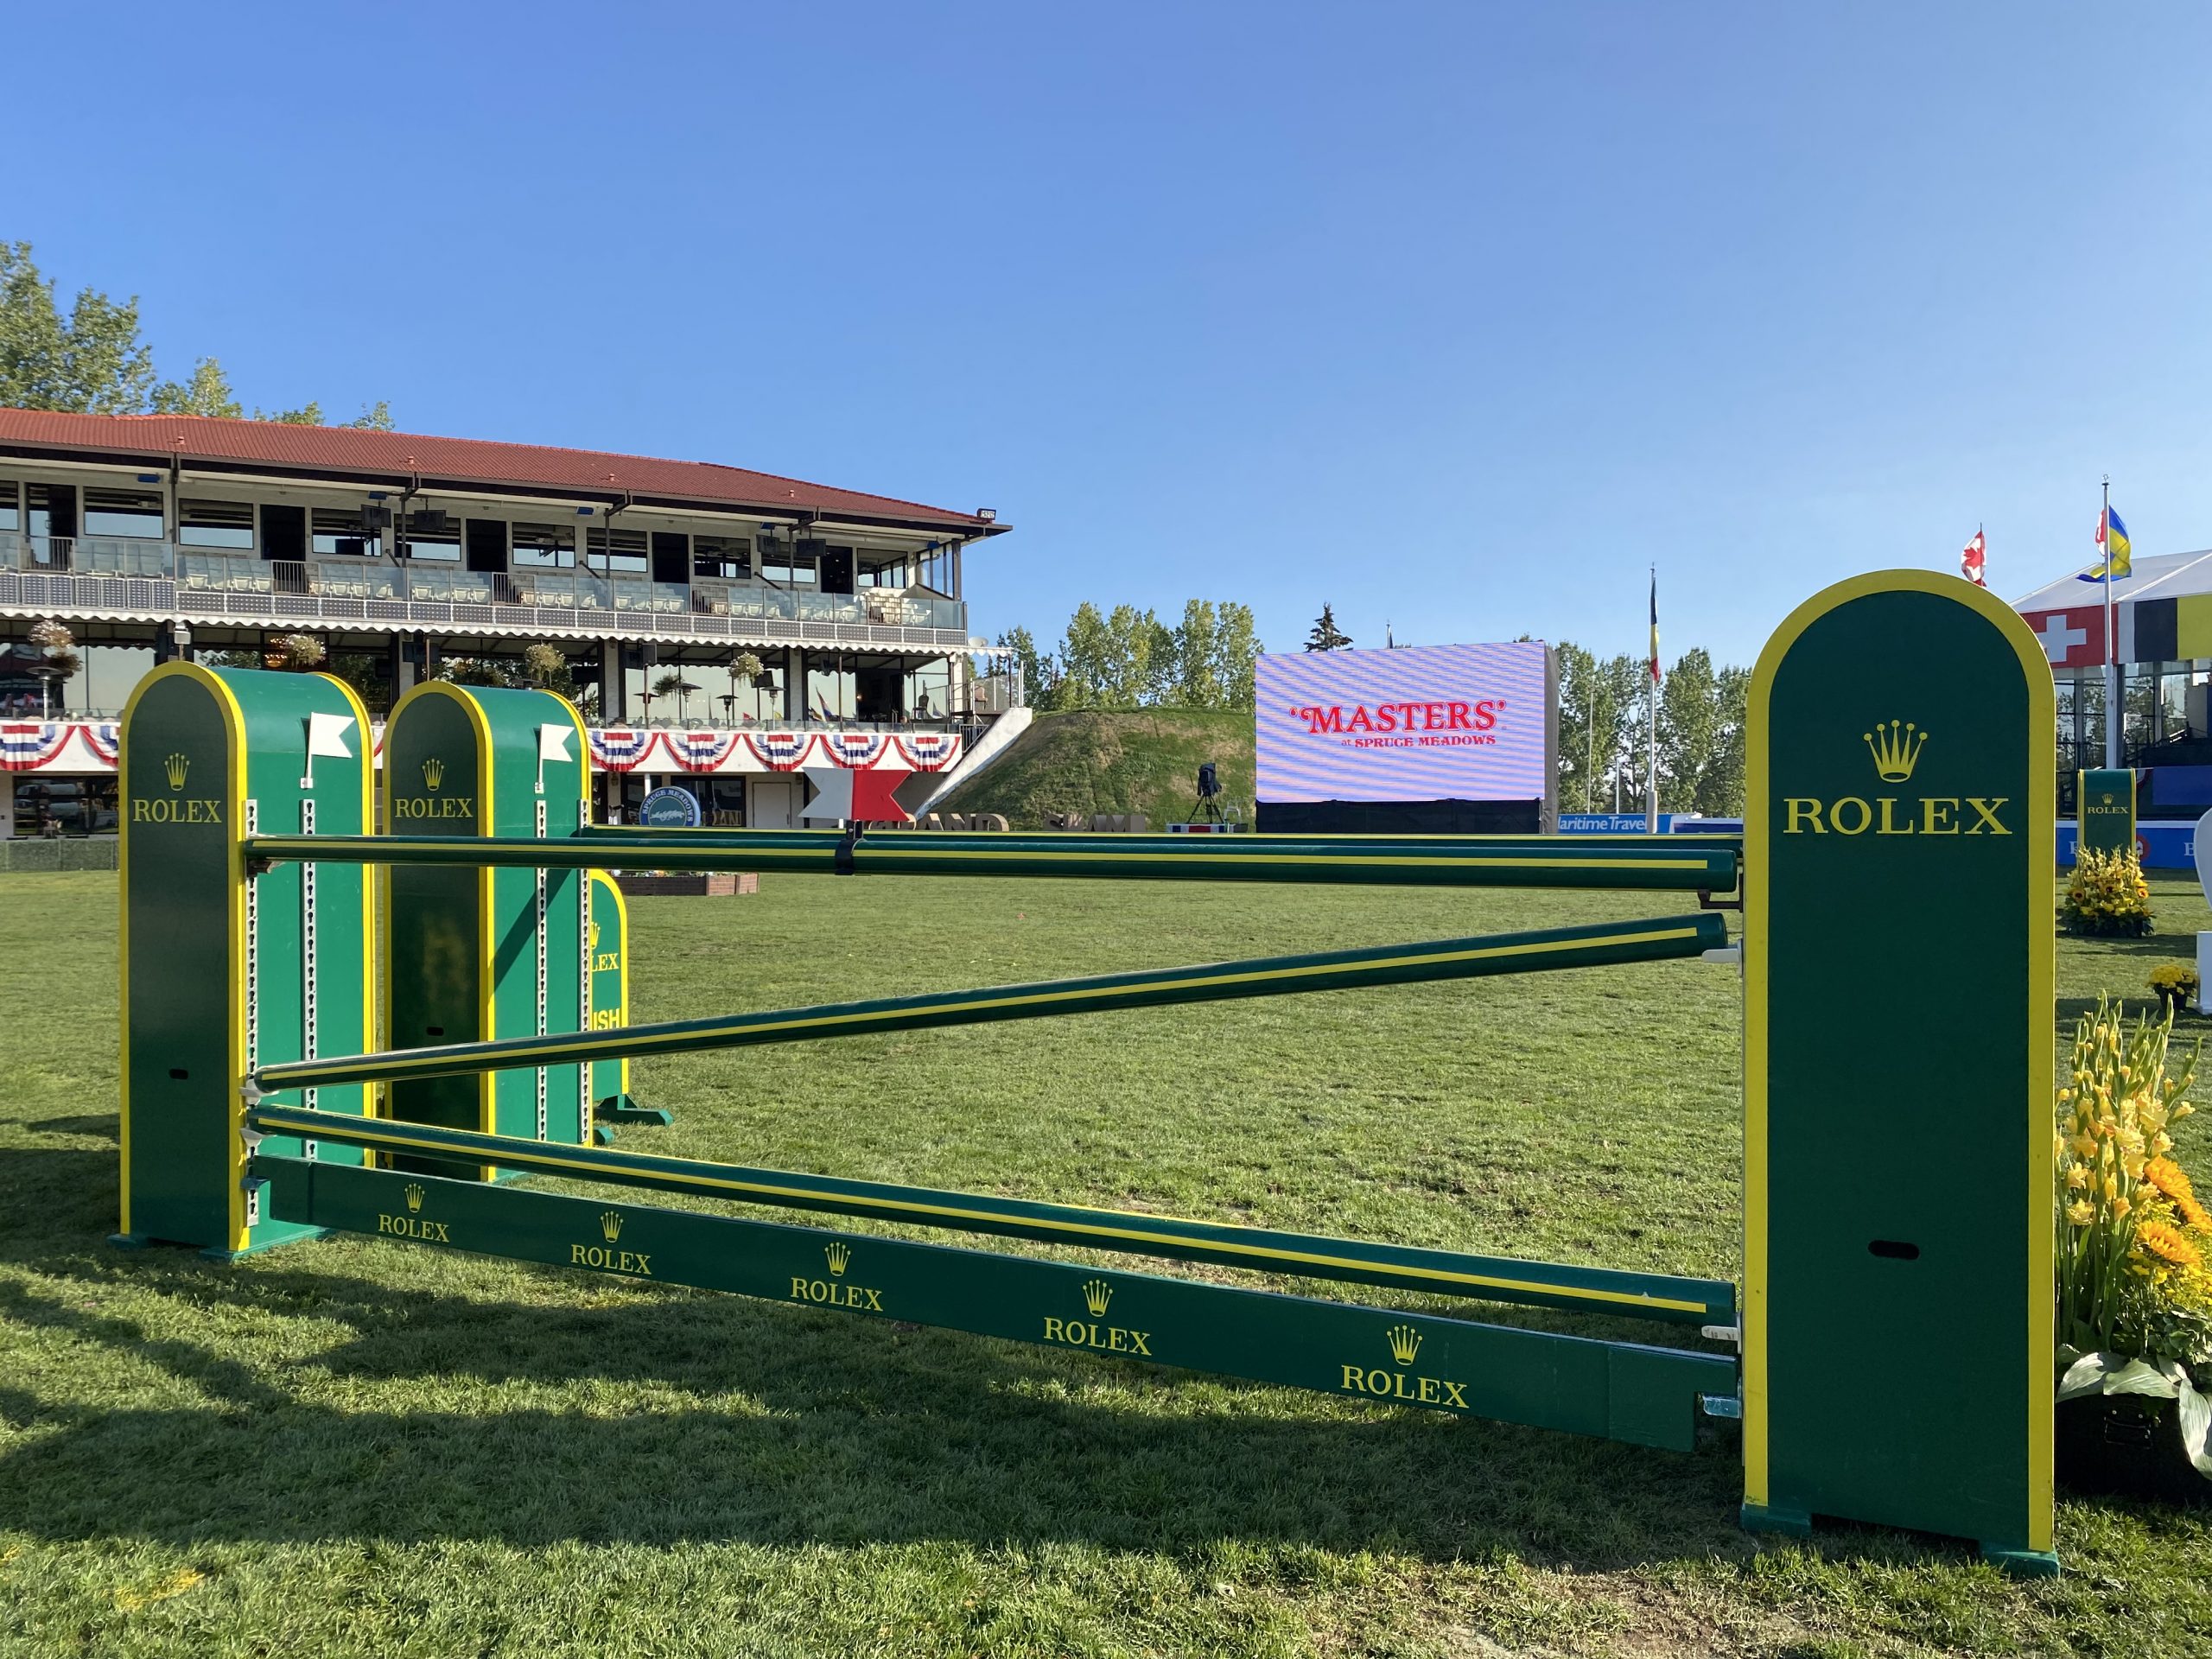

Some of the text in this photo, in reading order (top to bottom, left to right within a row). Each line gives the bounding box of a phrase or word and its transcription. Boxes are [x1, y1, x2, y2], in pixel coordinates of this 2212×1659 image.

[1355, 737, 1414, 747] SPRUCE
[1418, 735, 1496, 746] MEADOWS
[132, 798, 222, 823] ROLEX
[394, 798, 474, 818] ROLEX
[667, 790, 694, 822] MEADOWS
[1783, 797, 2013, 836] ROLEX
[591, 953, 620, 973] LEX
[593, 1008, 620, 1031] ISH
[378, 1214, 450, 1243] ROLEX
[570, 1243, 652, 1275] ROLEX
[790, 1276, 884, 1312] ROLEX
[1043, 1317, 1153, 1357] ROLEX
[1340, 1363, 1470, 1409] ROLEX
